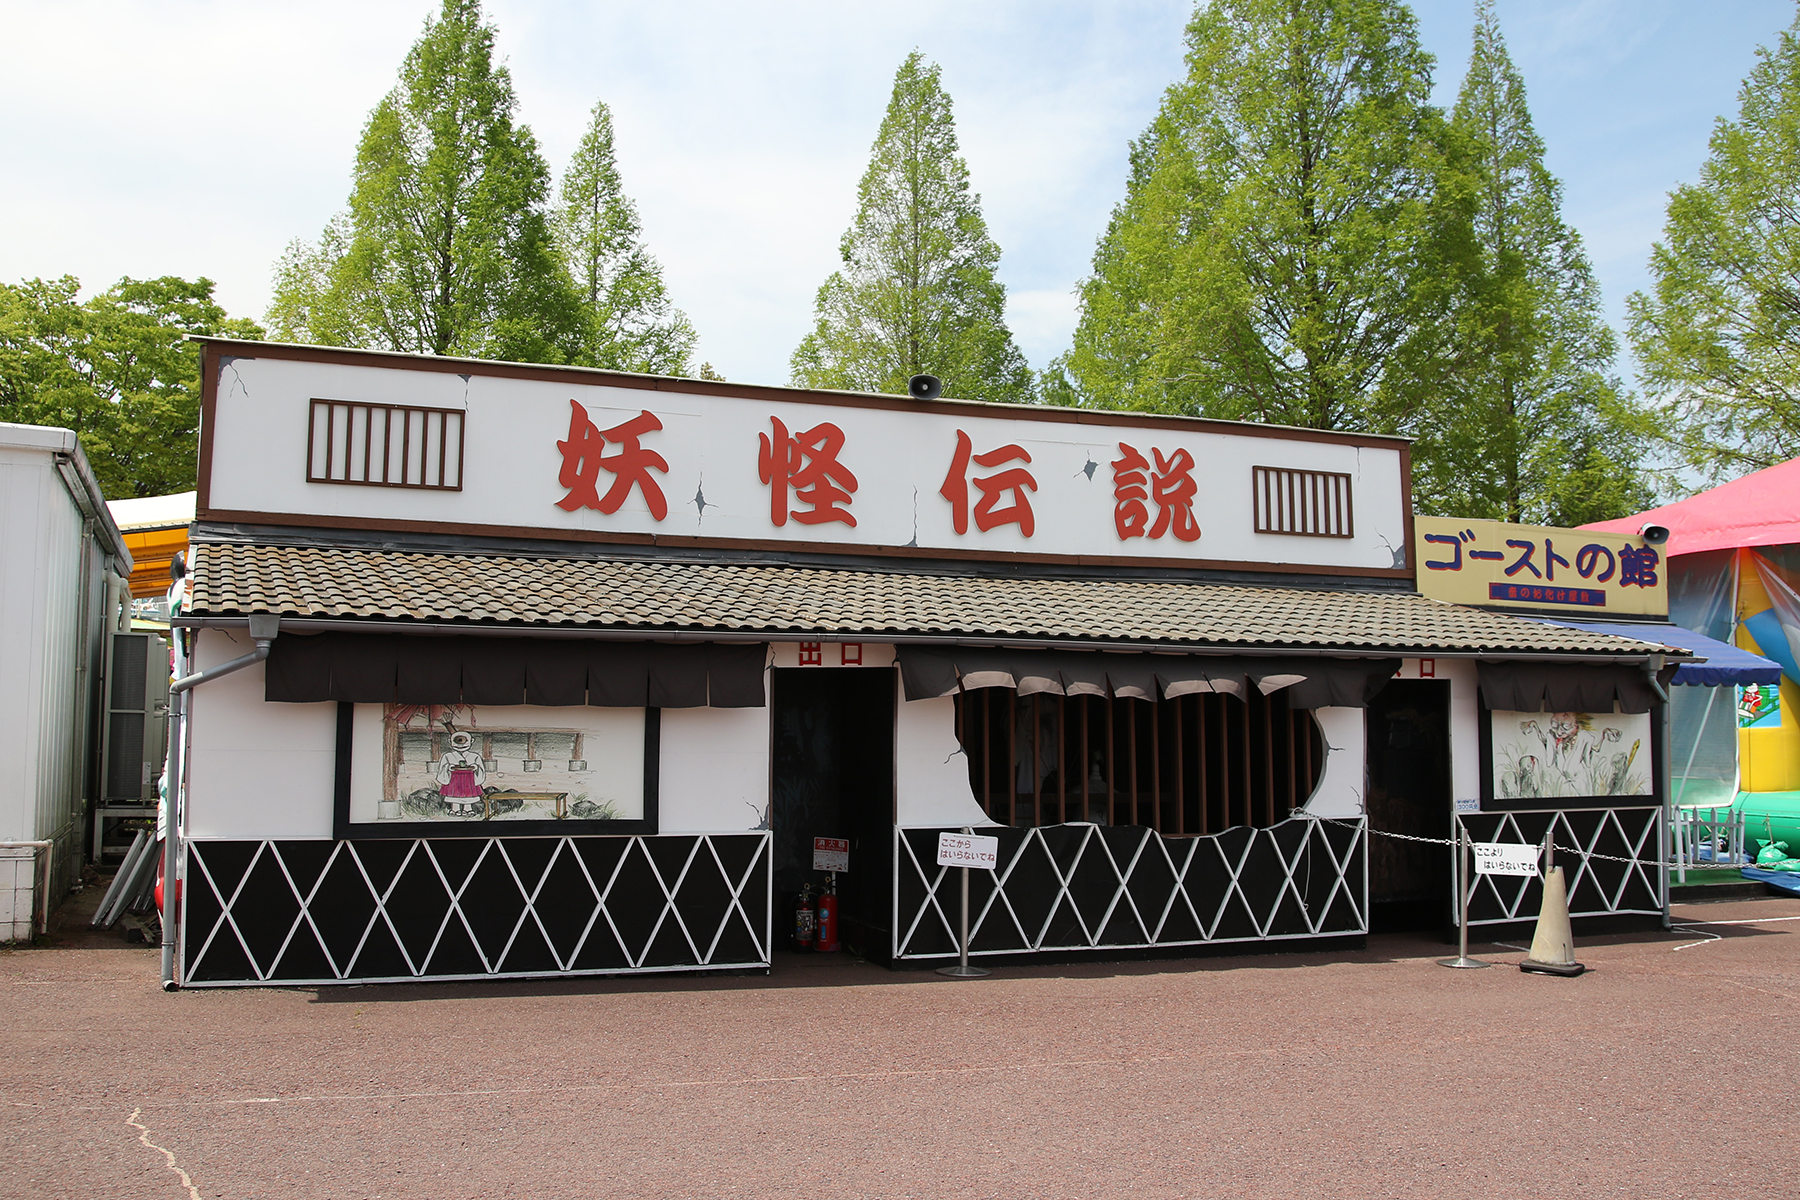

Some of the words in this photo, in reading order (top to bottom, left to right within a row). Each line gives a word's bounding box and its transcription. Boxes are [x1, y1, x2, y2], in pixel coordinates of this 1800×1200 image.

[554, 398, 1202, 542] 妖怪伝説
[1424, 528, 1659, 589] ゴーストの館
[799, 642, 862, 666] 出口
[818, 839, 845, 848] 消火器
[941, 838, 972, 849] ここから
[940, 849, 995, 862] はいらないでね
[1476, 847, 1503, 857] ここより
[1483, 860, 1536, 872] はいらないでね
